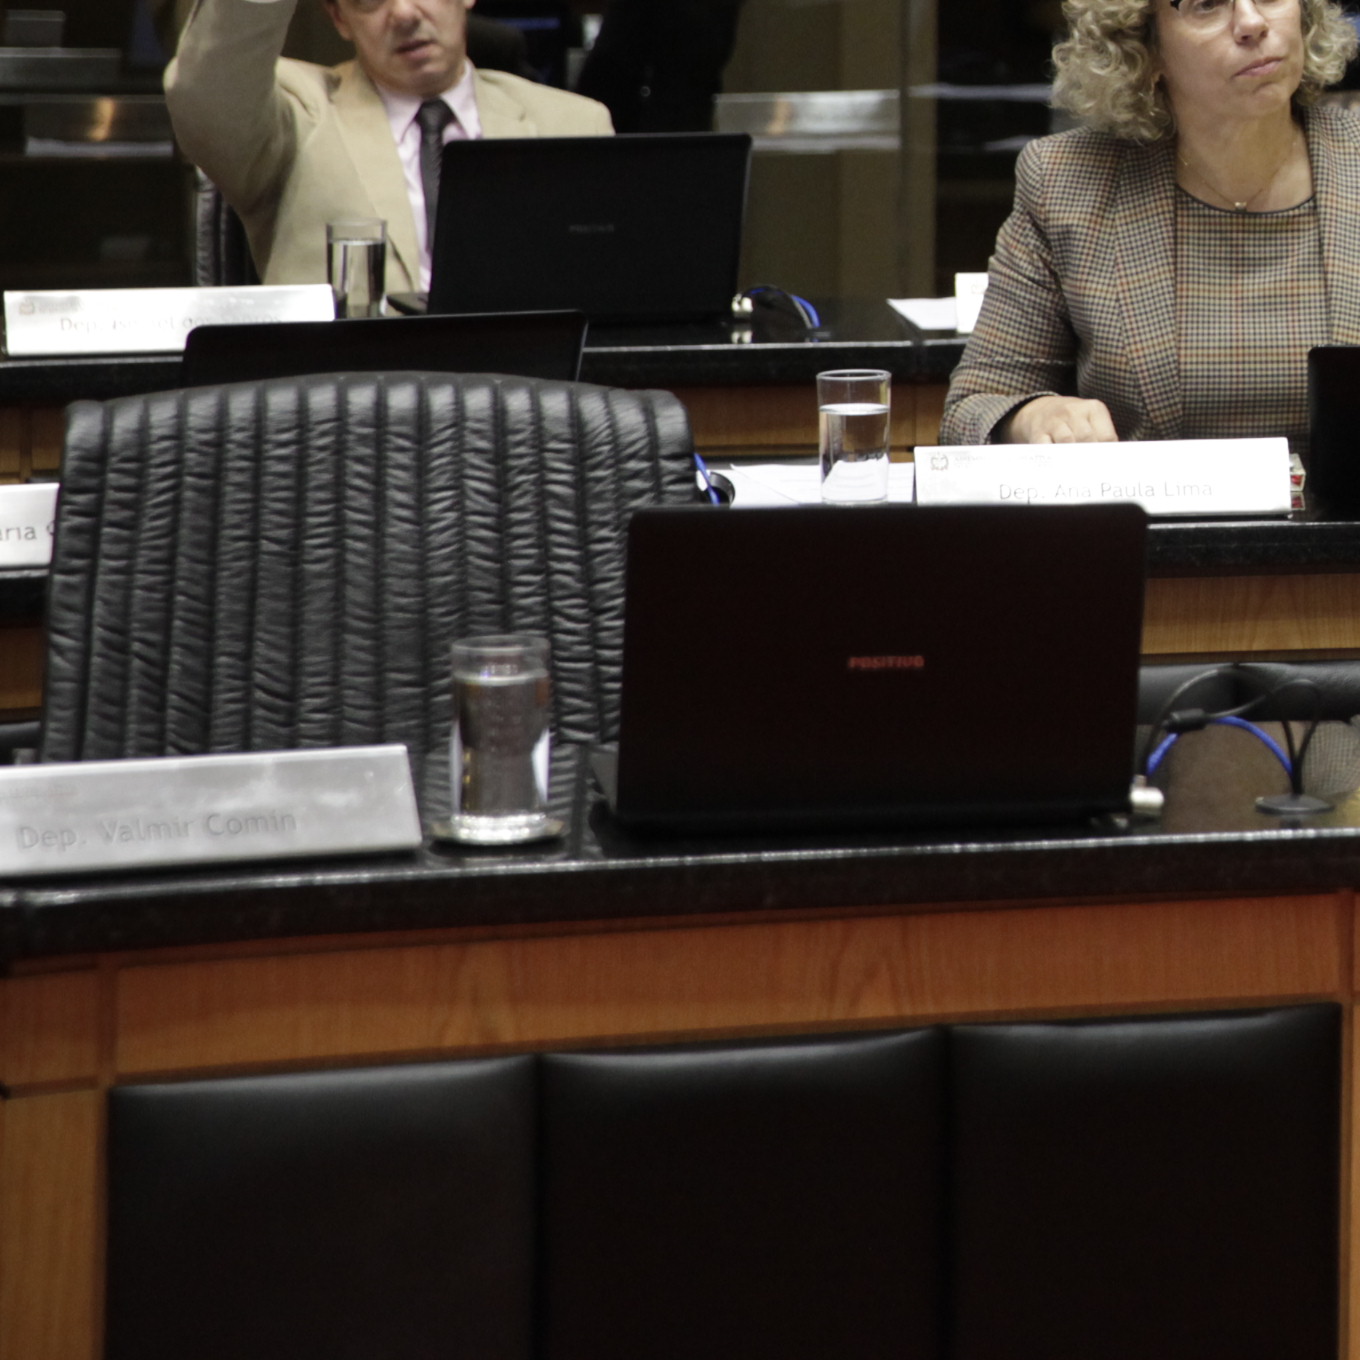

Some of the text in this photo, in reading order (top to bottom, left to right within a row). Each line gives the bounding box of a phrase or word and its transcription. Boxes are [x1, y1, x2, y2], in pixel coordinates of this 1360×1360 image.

[999, 483, 1046, 504] Dep.
[1100, 480, 1156, 498] Paula
[1163, 479, 1213, 497] Lima
[16, 808, 298, 852] Dep. Valmir Comin
